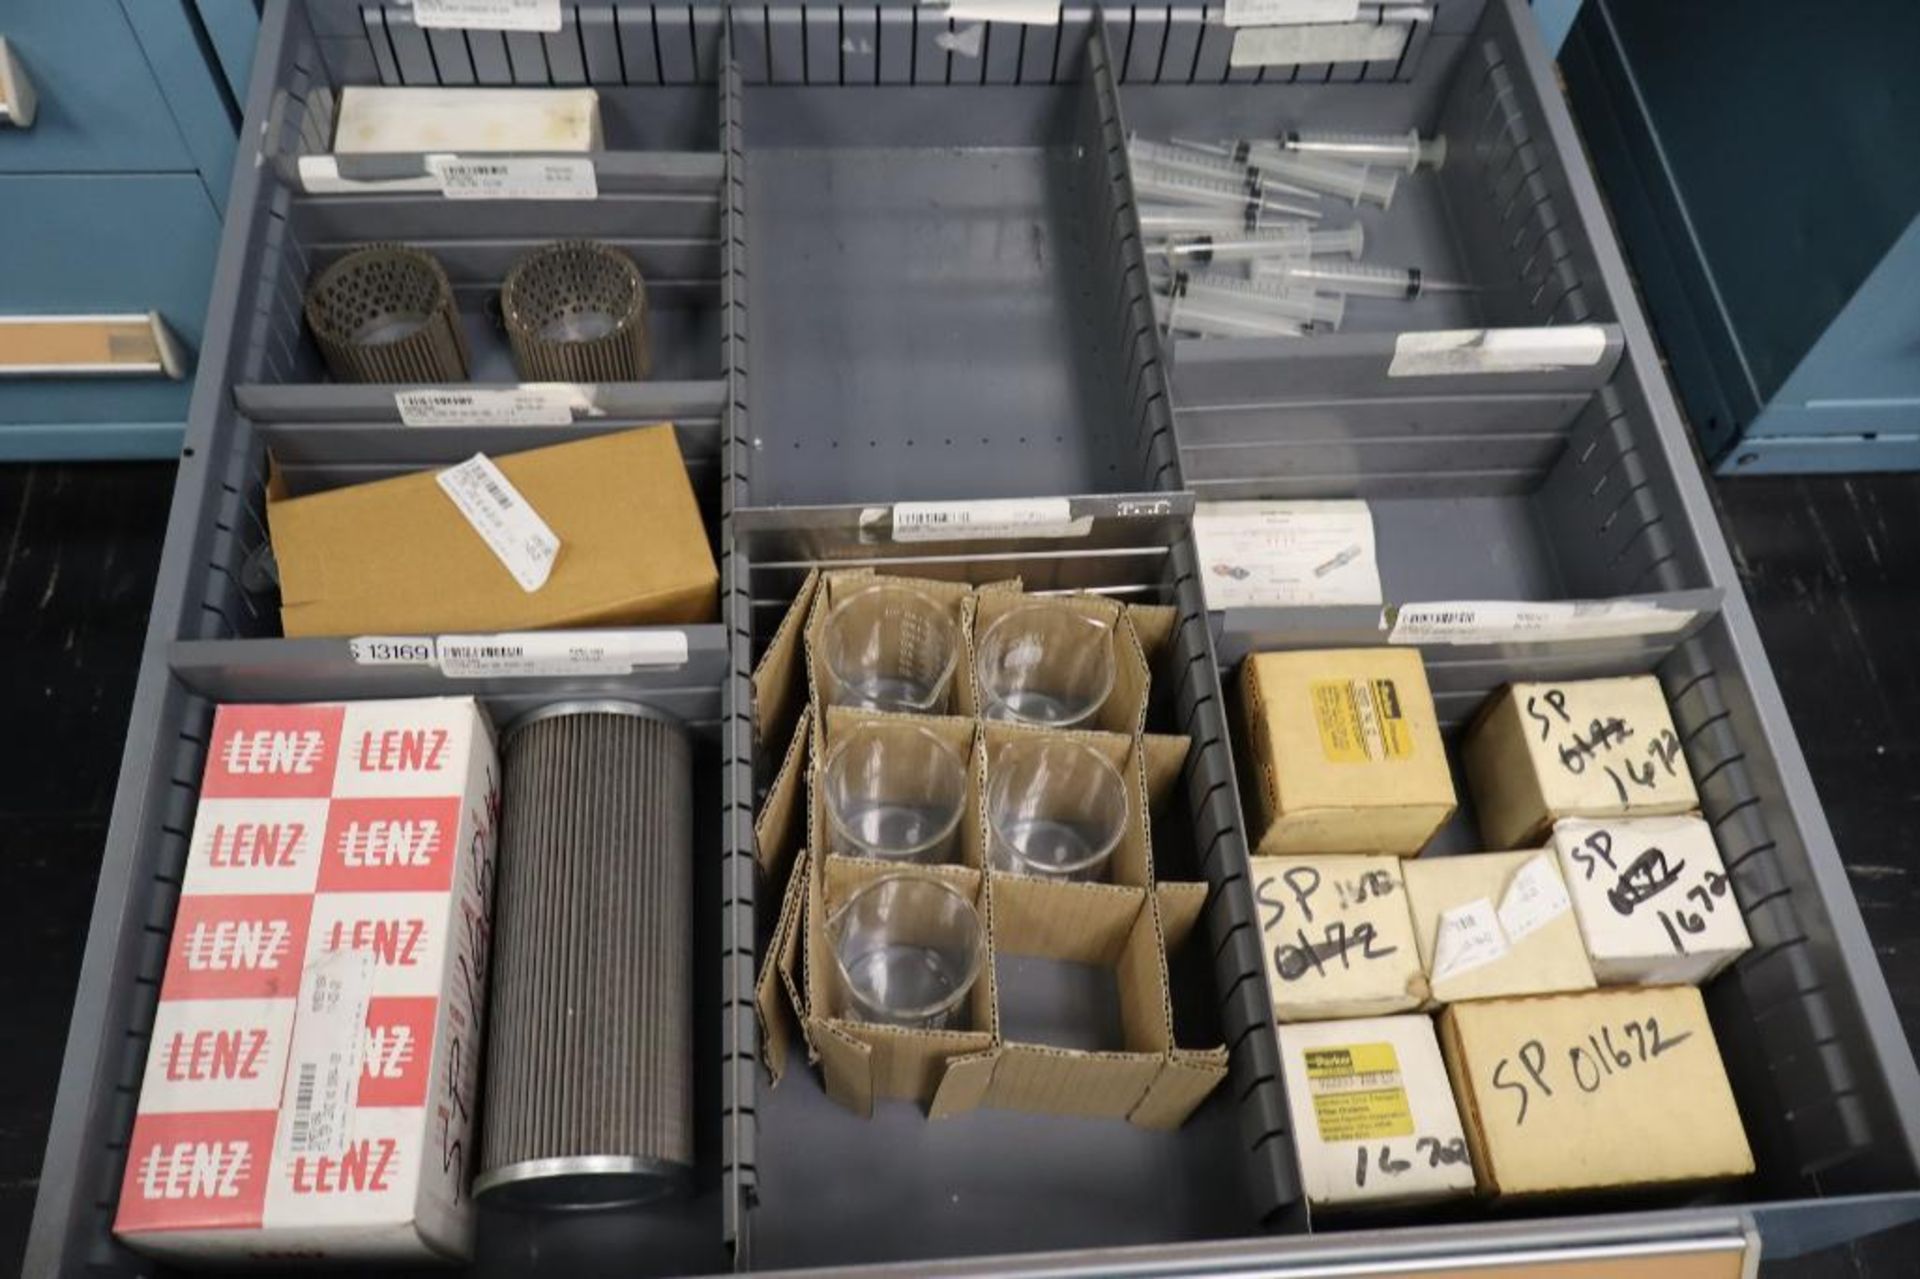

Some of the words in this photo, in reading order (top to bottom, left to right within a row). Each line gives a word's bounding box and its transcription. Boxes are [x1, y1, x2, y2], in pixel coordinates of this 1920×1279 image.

[369, 644, 429, 660] 13169
[1527, 690, 1570, 742] SP
[221, 731, 325, 773] LENZ
[353, 730, 450, 772] LENZ
[205, 824, 308, 868] LENZ
[337, 821, 440, 866] LENZ
[1571, 830, 1618, 880] SP
[1255, 866, 1322, 930] SP
[183, 921, 290, 969] LENZ
[324, 921, 428, 966] LENZ
[162, 1030, 270, 1081] LENZ
[362, 1025, 415, 1079] NZ
[1492, 1040, 1552, 1124] SP
[1570, 1016, 1694, 1092] 01672
[137, 1142, 251, 1199] LENZ
